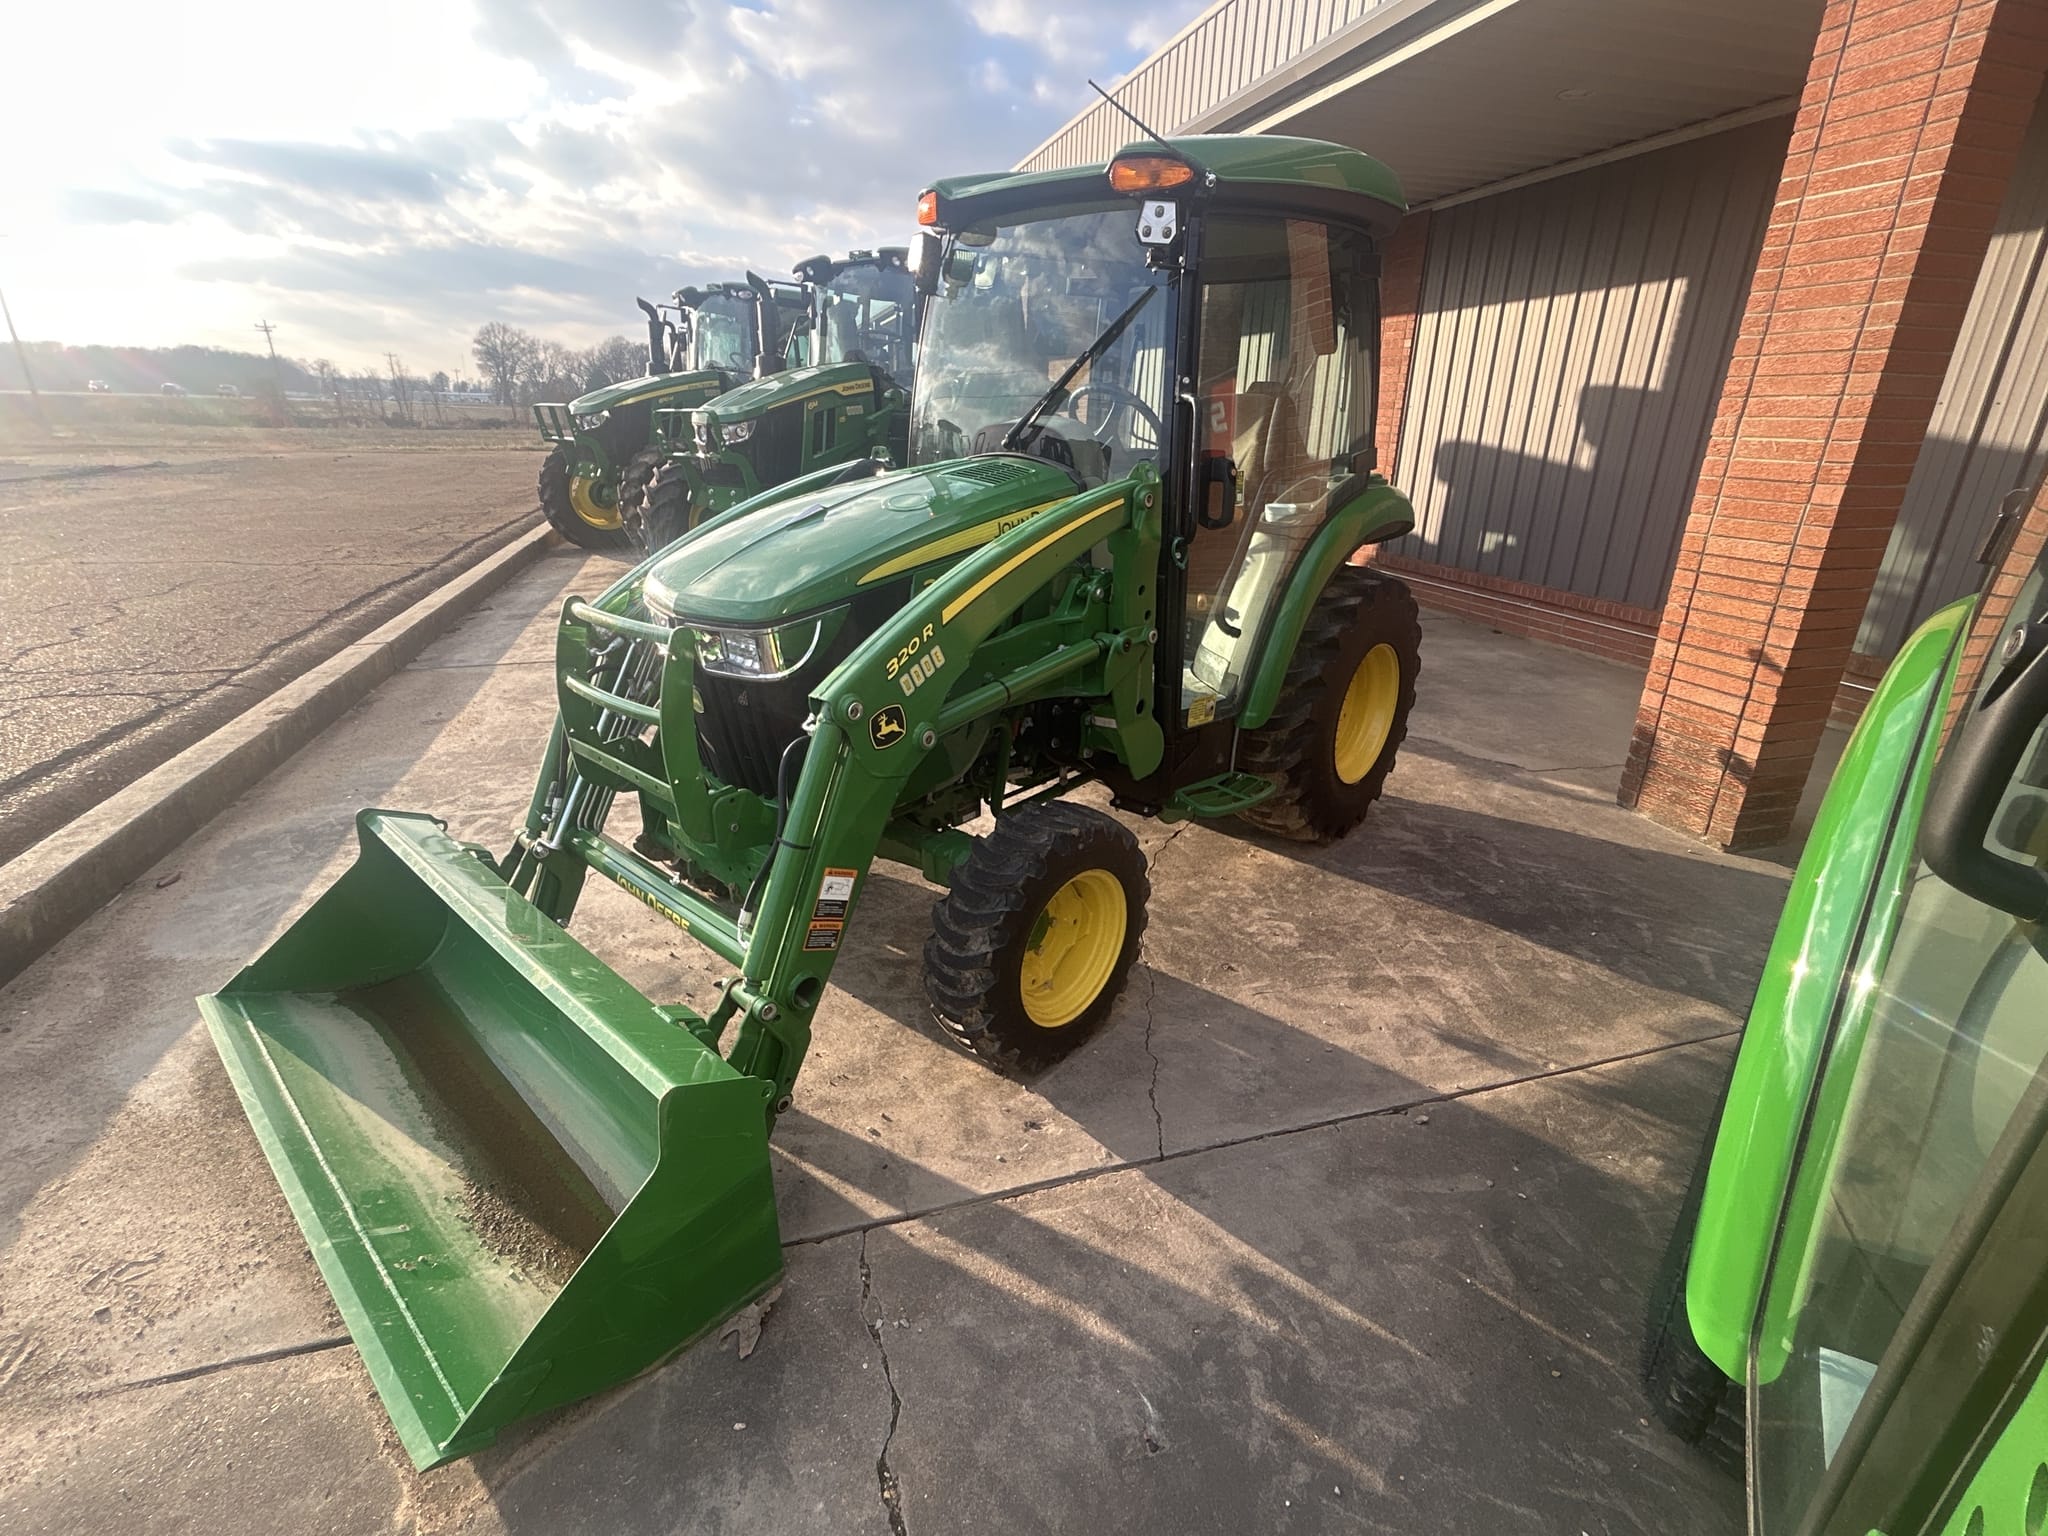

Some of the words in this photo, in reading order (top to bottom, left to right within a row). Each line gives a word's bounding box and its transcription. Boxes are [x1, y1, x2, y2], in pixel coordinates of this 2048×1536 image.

[886, 636, 920, 681] 320
[922, 623, 934, 643] R
[616, 872, 644, 901] JOHN
